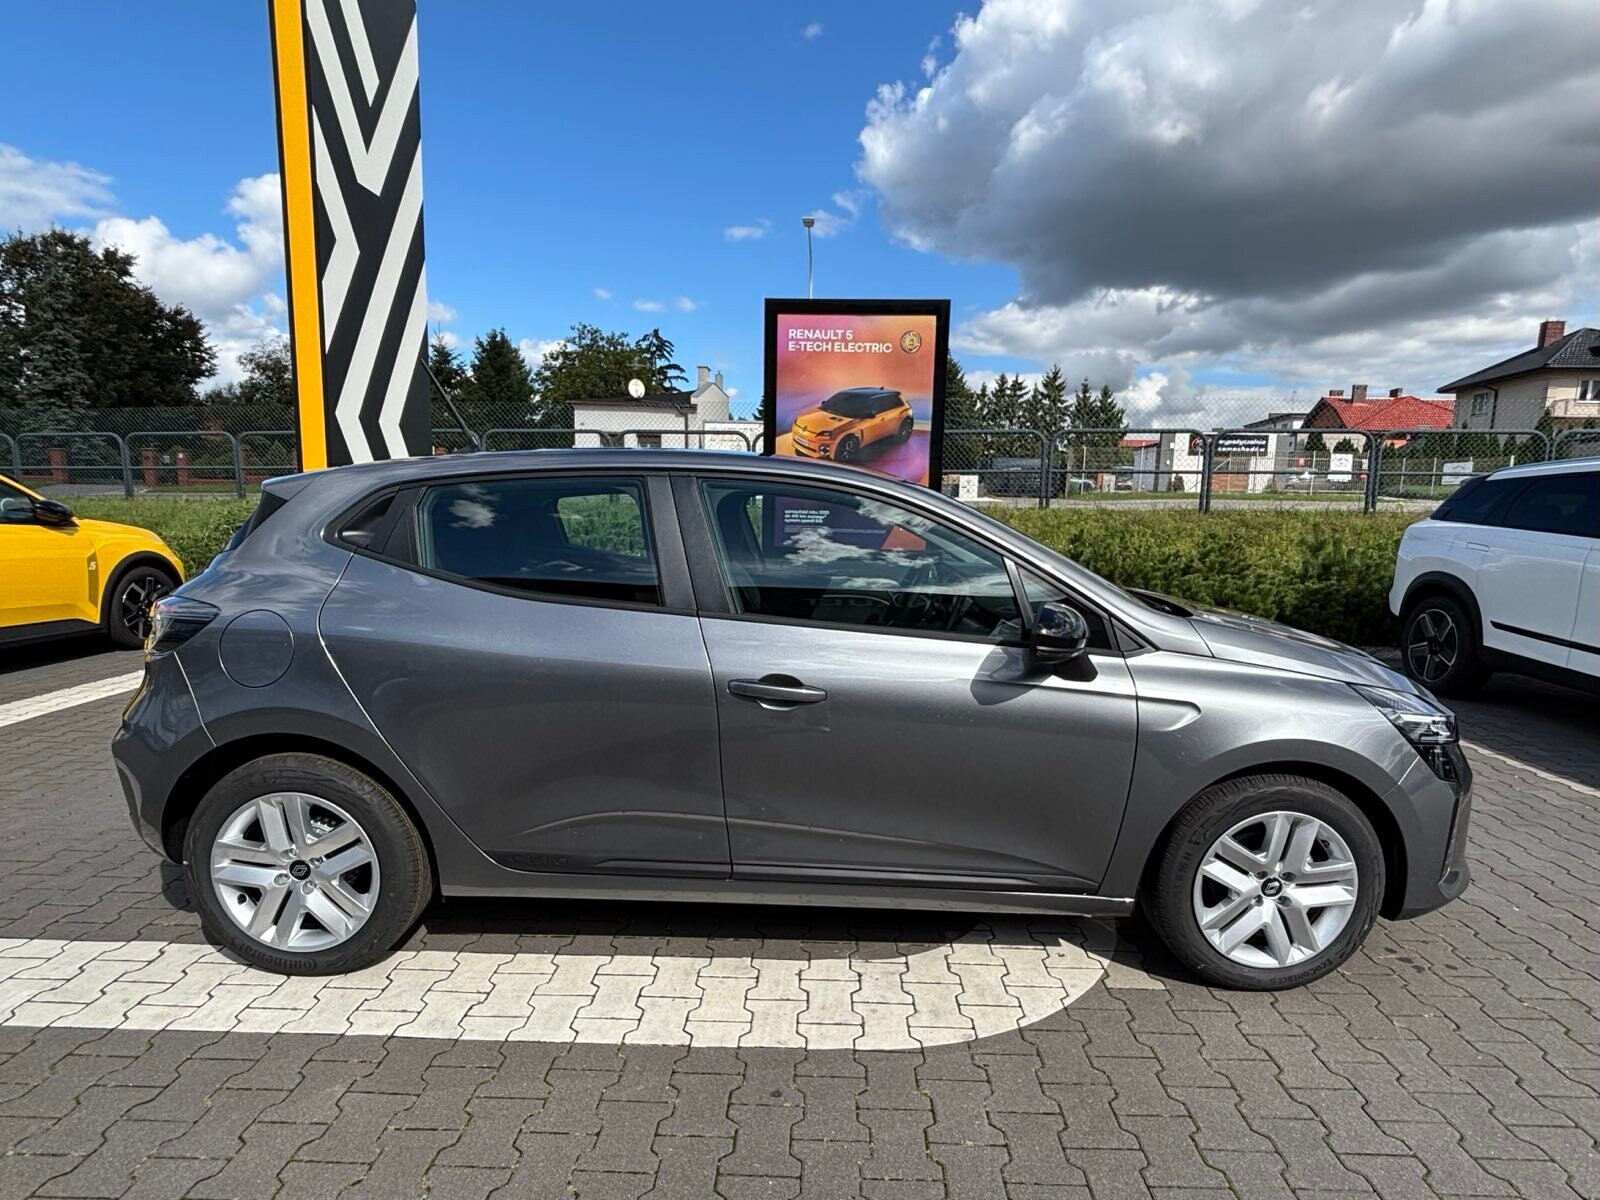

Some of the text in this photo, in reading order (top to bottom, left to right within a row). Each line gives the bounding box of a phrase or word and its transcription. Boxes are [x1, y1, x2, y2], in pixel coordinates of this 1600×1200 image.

[788, 329, 853, 340] RENAULT 5
[788, 342, 893, 353] E-TECH ELECTRIC
[239, 942, 318, 970] Continental
